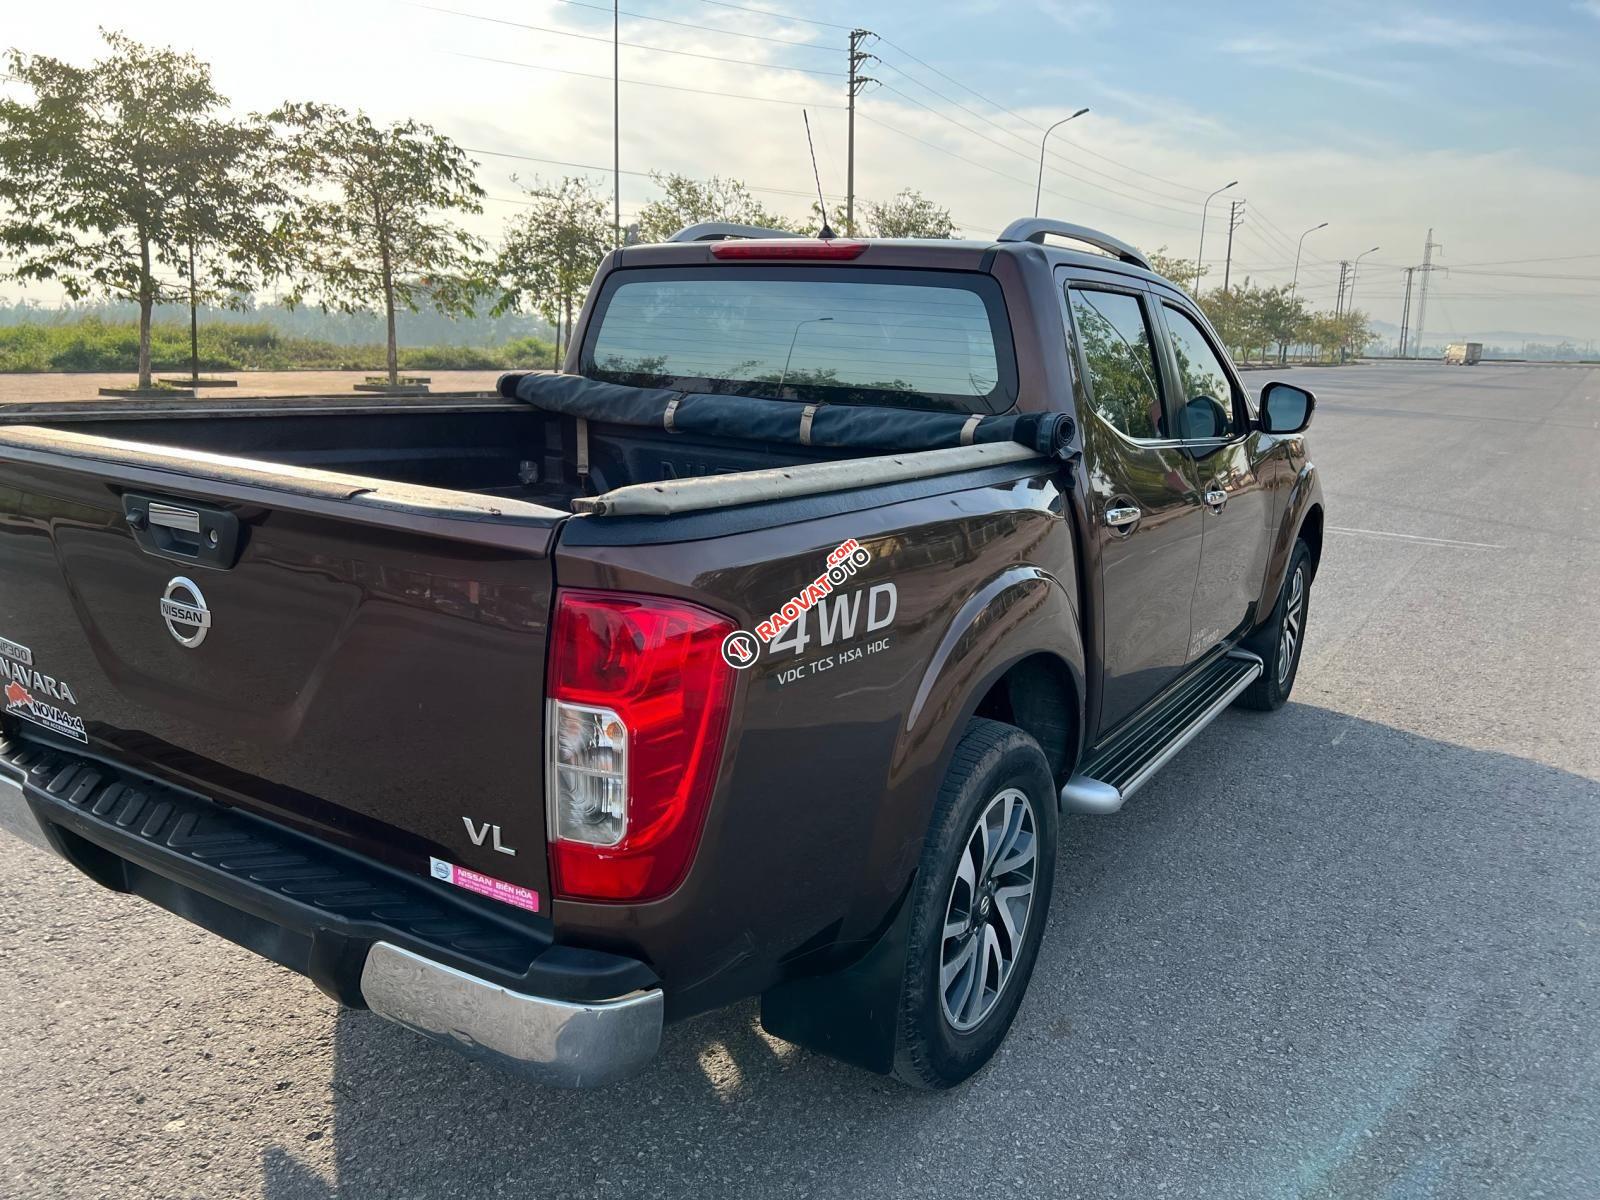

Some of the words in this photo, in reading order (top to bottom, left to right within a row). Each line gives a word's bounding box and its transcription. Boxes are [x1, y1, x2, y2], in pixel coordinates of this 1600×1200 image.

[162, 603, 203, 624] NISSAN
[769, 582, 898, 655] 4WD
[0, 656, 76, 705] NAVARA
[777, 666, 805, 685] VDC
[809, 656, 834, 674] TCS
[839, 647, 863, 665] HSA
[867, 638, 890, 655] HDC
[462, 816, 516, 856] VL
[457, 868, 492, 887] NISSAN
